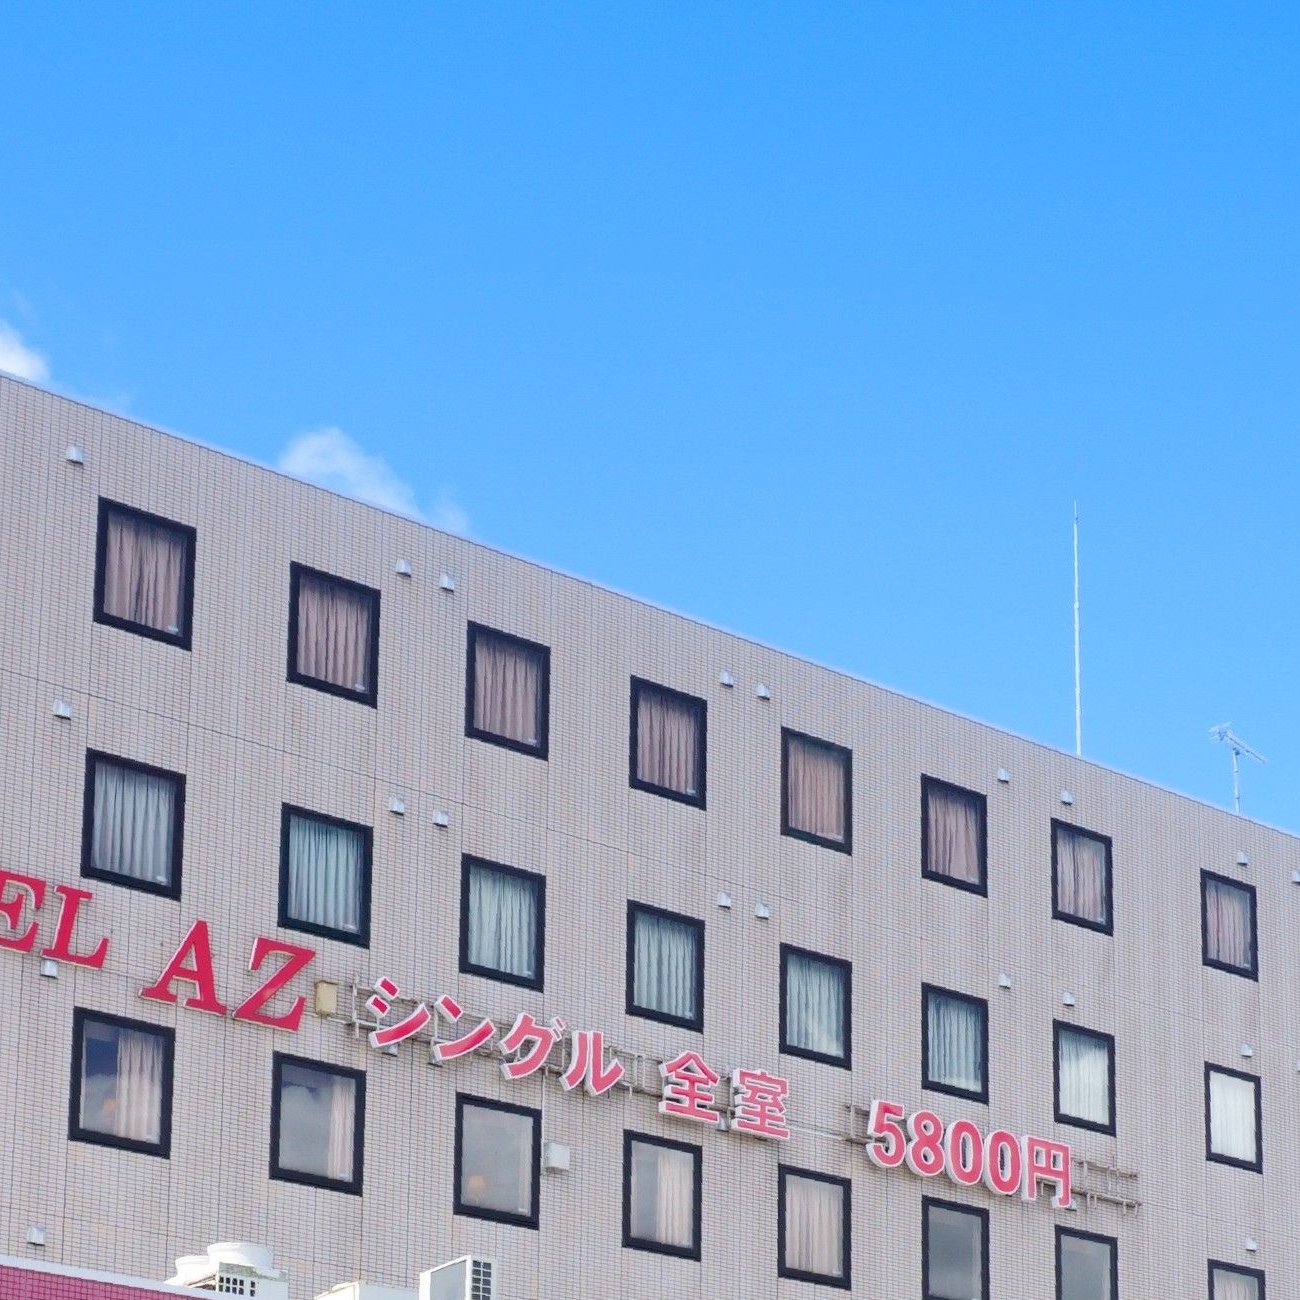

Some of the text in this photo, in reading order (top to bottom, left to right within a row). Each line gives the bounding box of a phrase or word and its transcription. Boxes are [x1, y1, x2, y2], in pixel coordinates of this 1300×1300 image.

[138, 919, 317, 1032] AZ
[364, 975, 1073, 1208] シングル 全室 5800円
